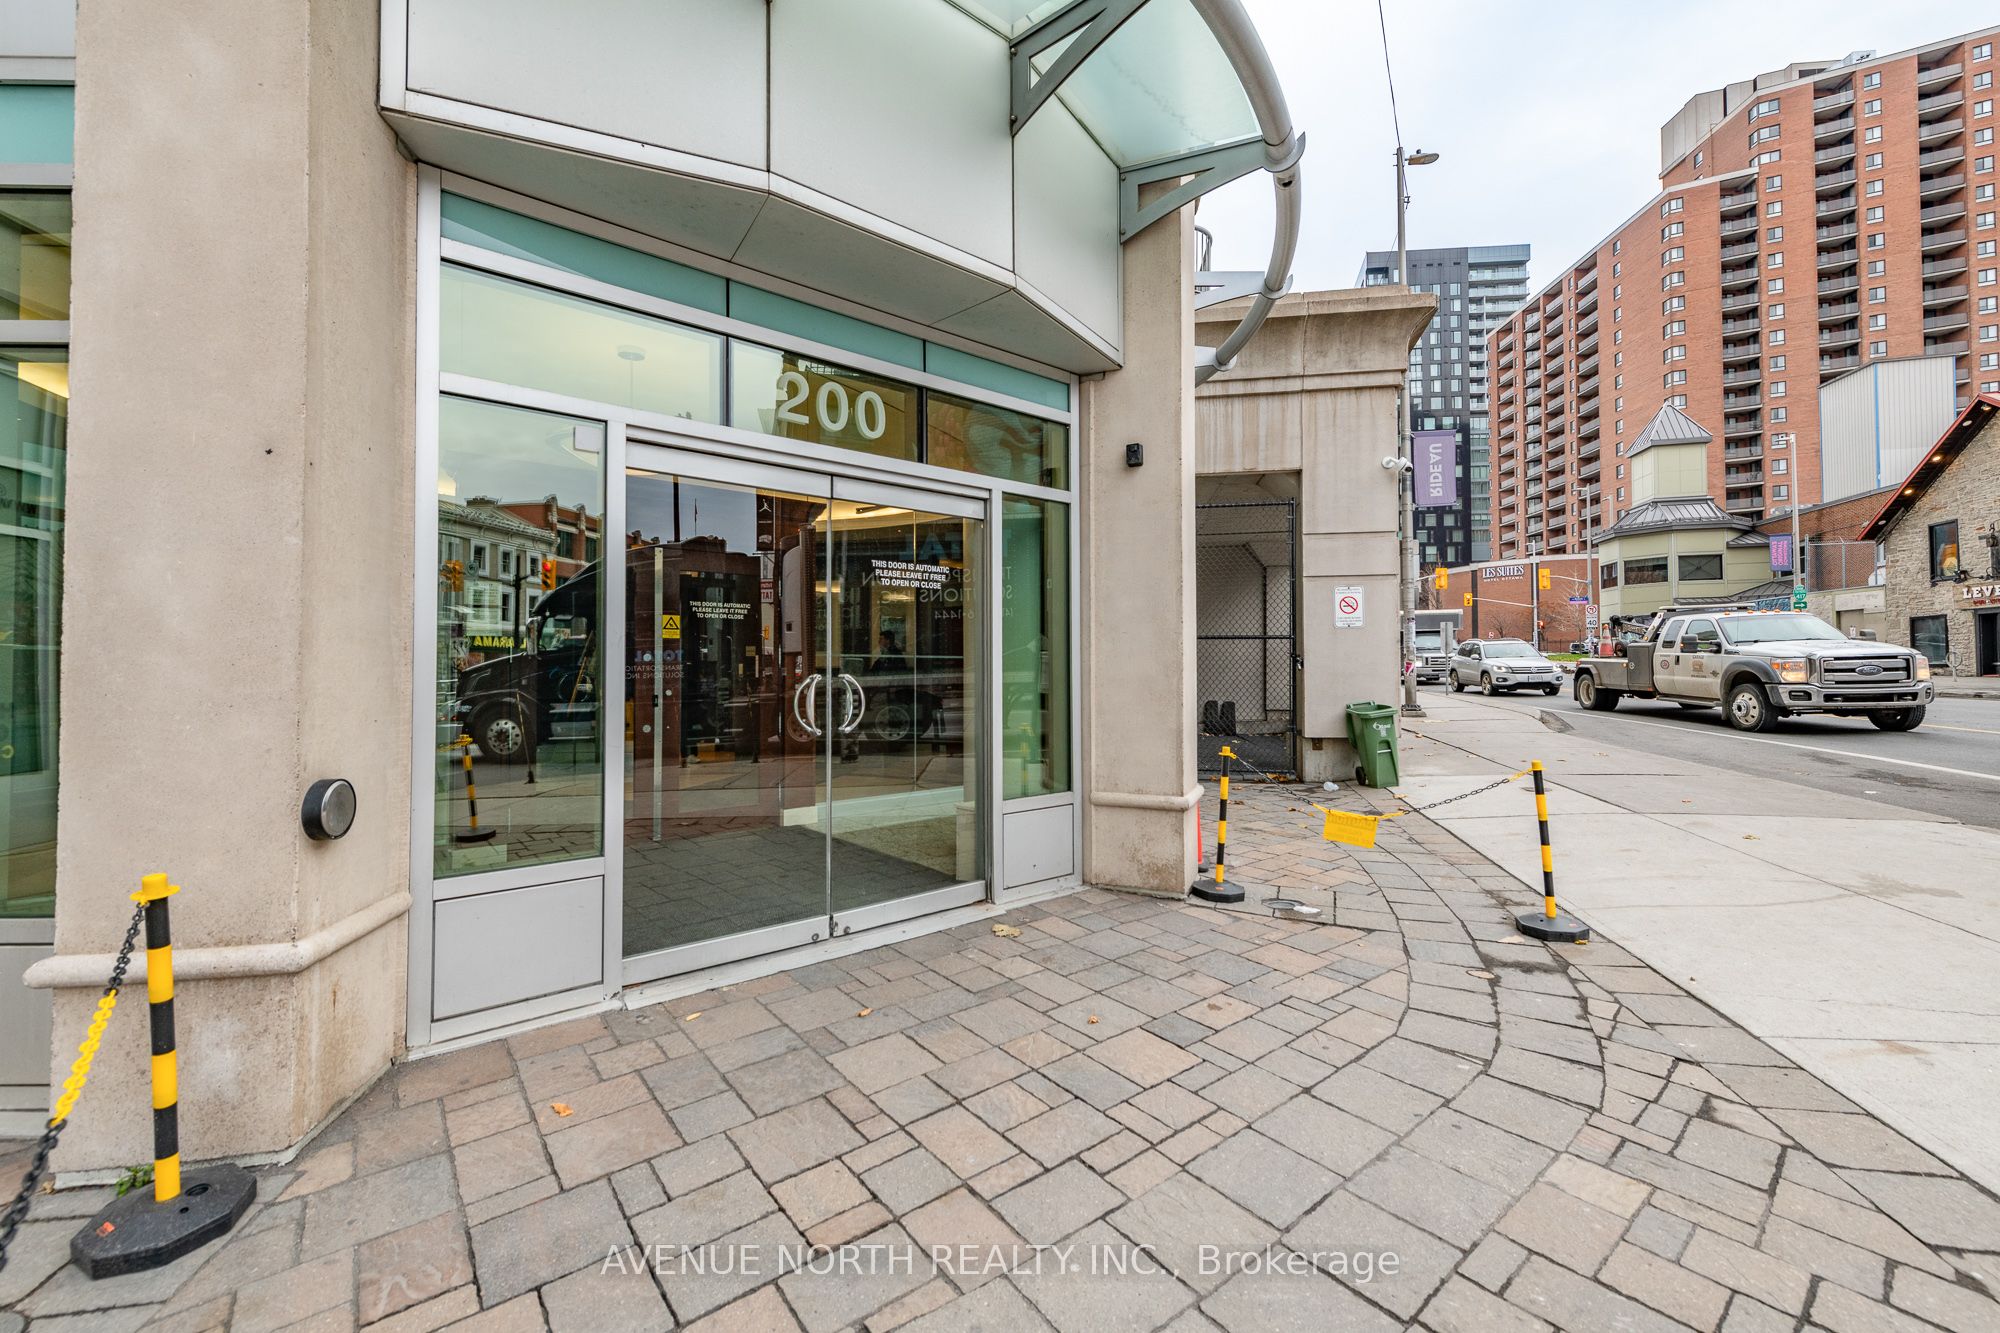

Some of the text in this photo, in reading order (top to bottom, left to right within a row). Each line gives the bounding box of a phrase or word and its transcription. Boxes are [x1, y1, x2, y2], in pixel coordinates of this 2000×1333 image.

[776, 371, 886, 440] 200
[888, 561, 907, 569] DOOR
[915, 564, 950, 574] AUTOMATIC
[1482, 565, 1524, 578] LES SUITES
[875, 569, 902, 578] PLEASE
[902, 571, 923, 580] LEAVE
[930, 574, 947, 582] FREE
[891, 579, 910, 587] OPEN
[920, 581, 942, 590] CLOSE
